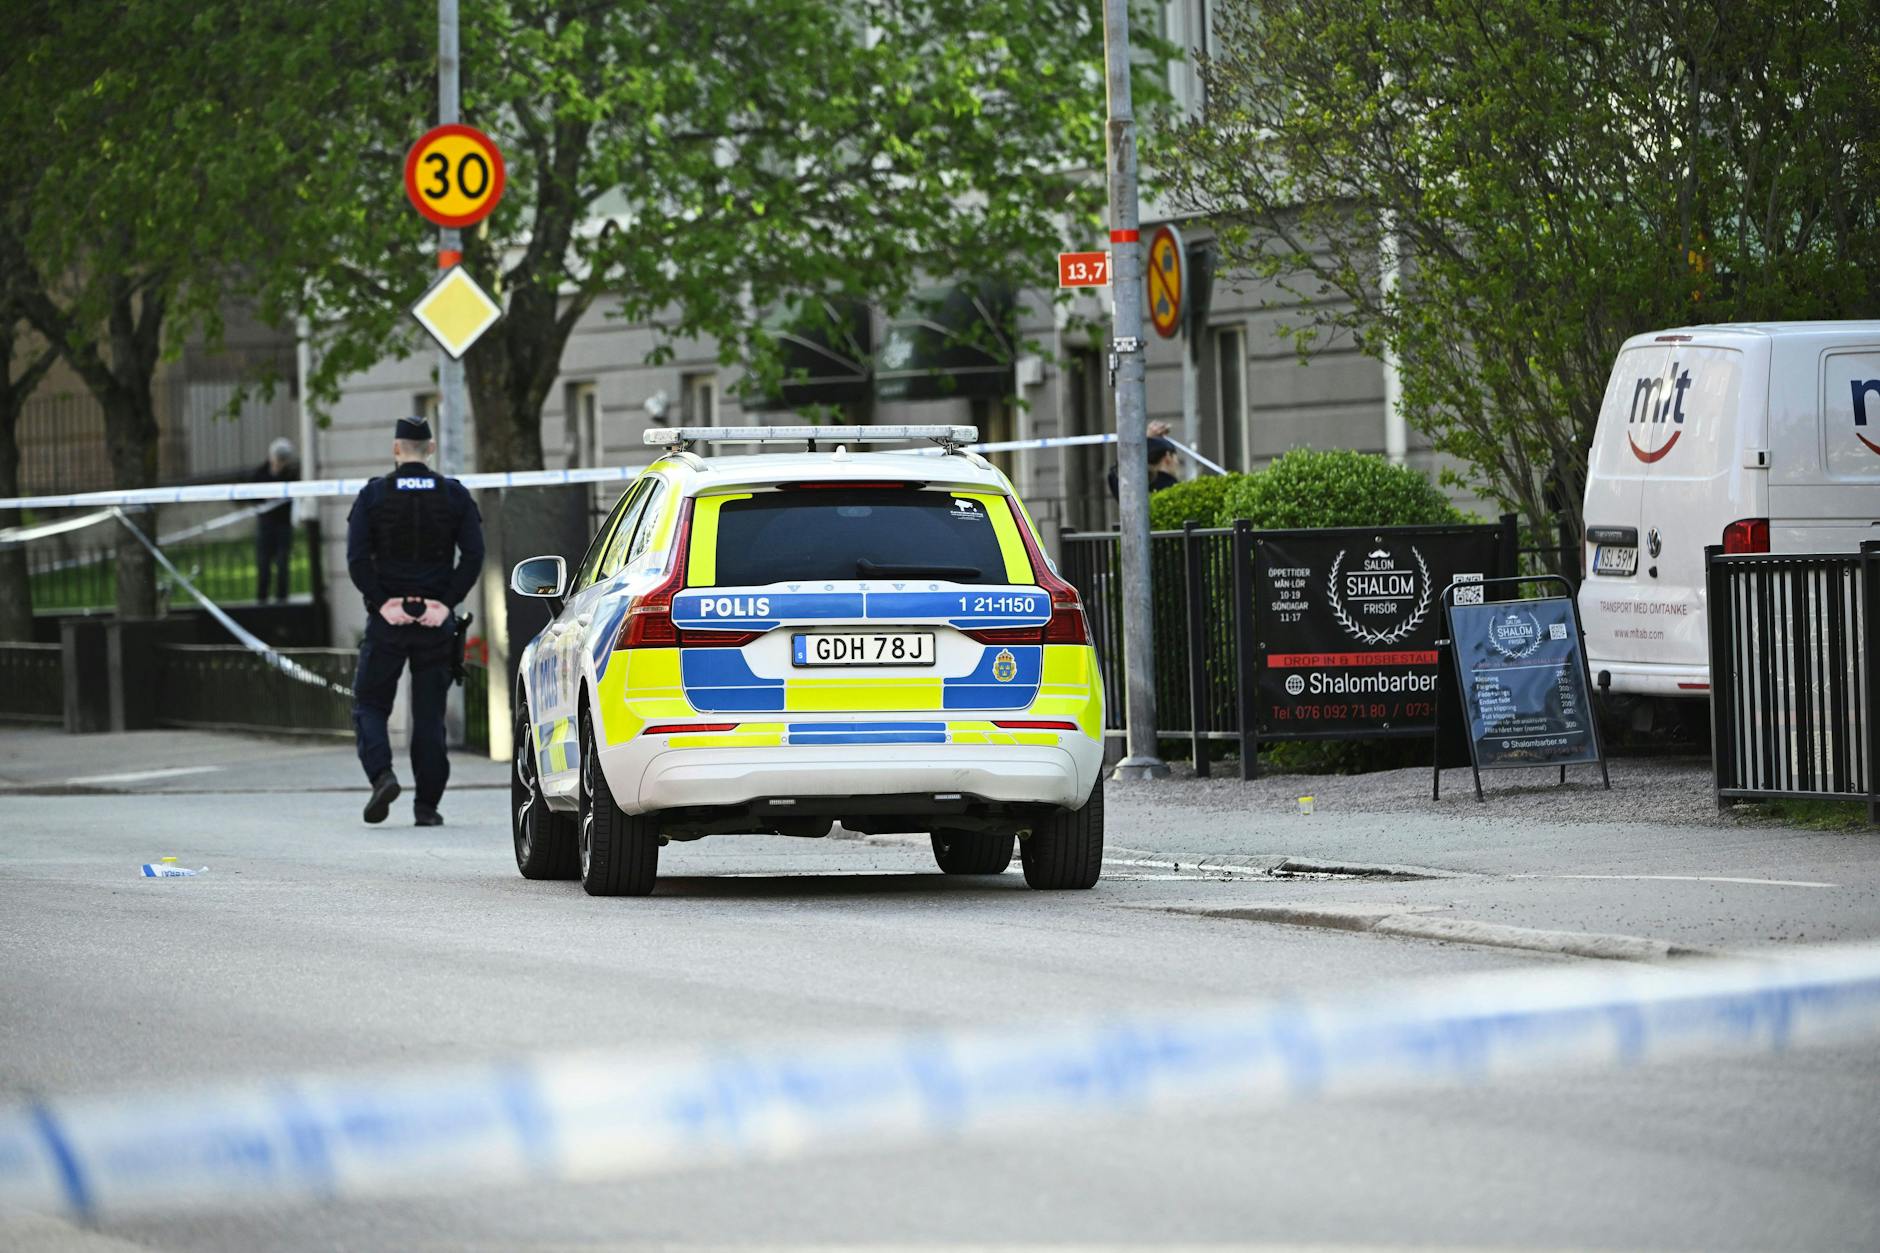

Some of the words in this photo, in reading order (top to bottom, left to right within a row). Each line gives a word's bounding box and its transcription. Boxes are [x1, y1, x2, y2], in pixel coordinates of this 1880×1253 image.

[424, 152, 489, 200] 30
[1067, 262, 1105, 282] 13,7
[1629, 361, 1693, 424] mlt
[397, 478, 435, 489] POLIS
[1364, 559, 1394, 571] SALON
[1599, 548, 1614, 568] NSL
[1615, 549, 1634, 568] 59M
[1268, 567, 1311, 578] ÖPPETTIDER
[1346, 575, 1414, 596] SHALOM
[700, 597, 770, 617] POLIS
[958, 596, 967, 612] 1
[973, 596, 1036, 613] 21-1150
[1271, 600, 1309, 611] SÖNDAGAR
[1363, 602, 1398, 615] FRISÖR
[1600, 601, 1632, 614] TRANSPORT
[1633, 602, 1648, 614] MED
[1649, 603, 1688, 615] OMTANKE
[1280, 613, 1302, 622] 11-17
[1497, 626, 1533, 638] SHALOM
[816, 638, 864, 659] GDH
[874, 637, 922, 659] 78J
[1284, 656, 1319, 666] DROP
[1323, 655, 1335, 665] IN
[1309, 671, 1438, 694] Shalombarber
[1295, 705, 1320, 719] 076
[1324, 704, 1347, 718] 092
[1352, 704, 1366, 718] 71
[1370, 703, 1386, 717] 80
[1511, 738, 1567, 749] Shalombarber.se
